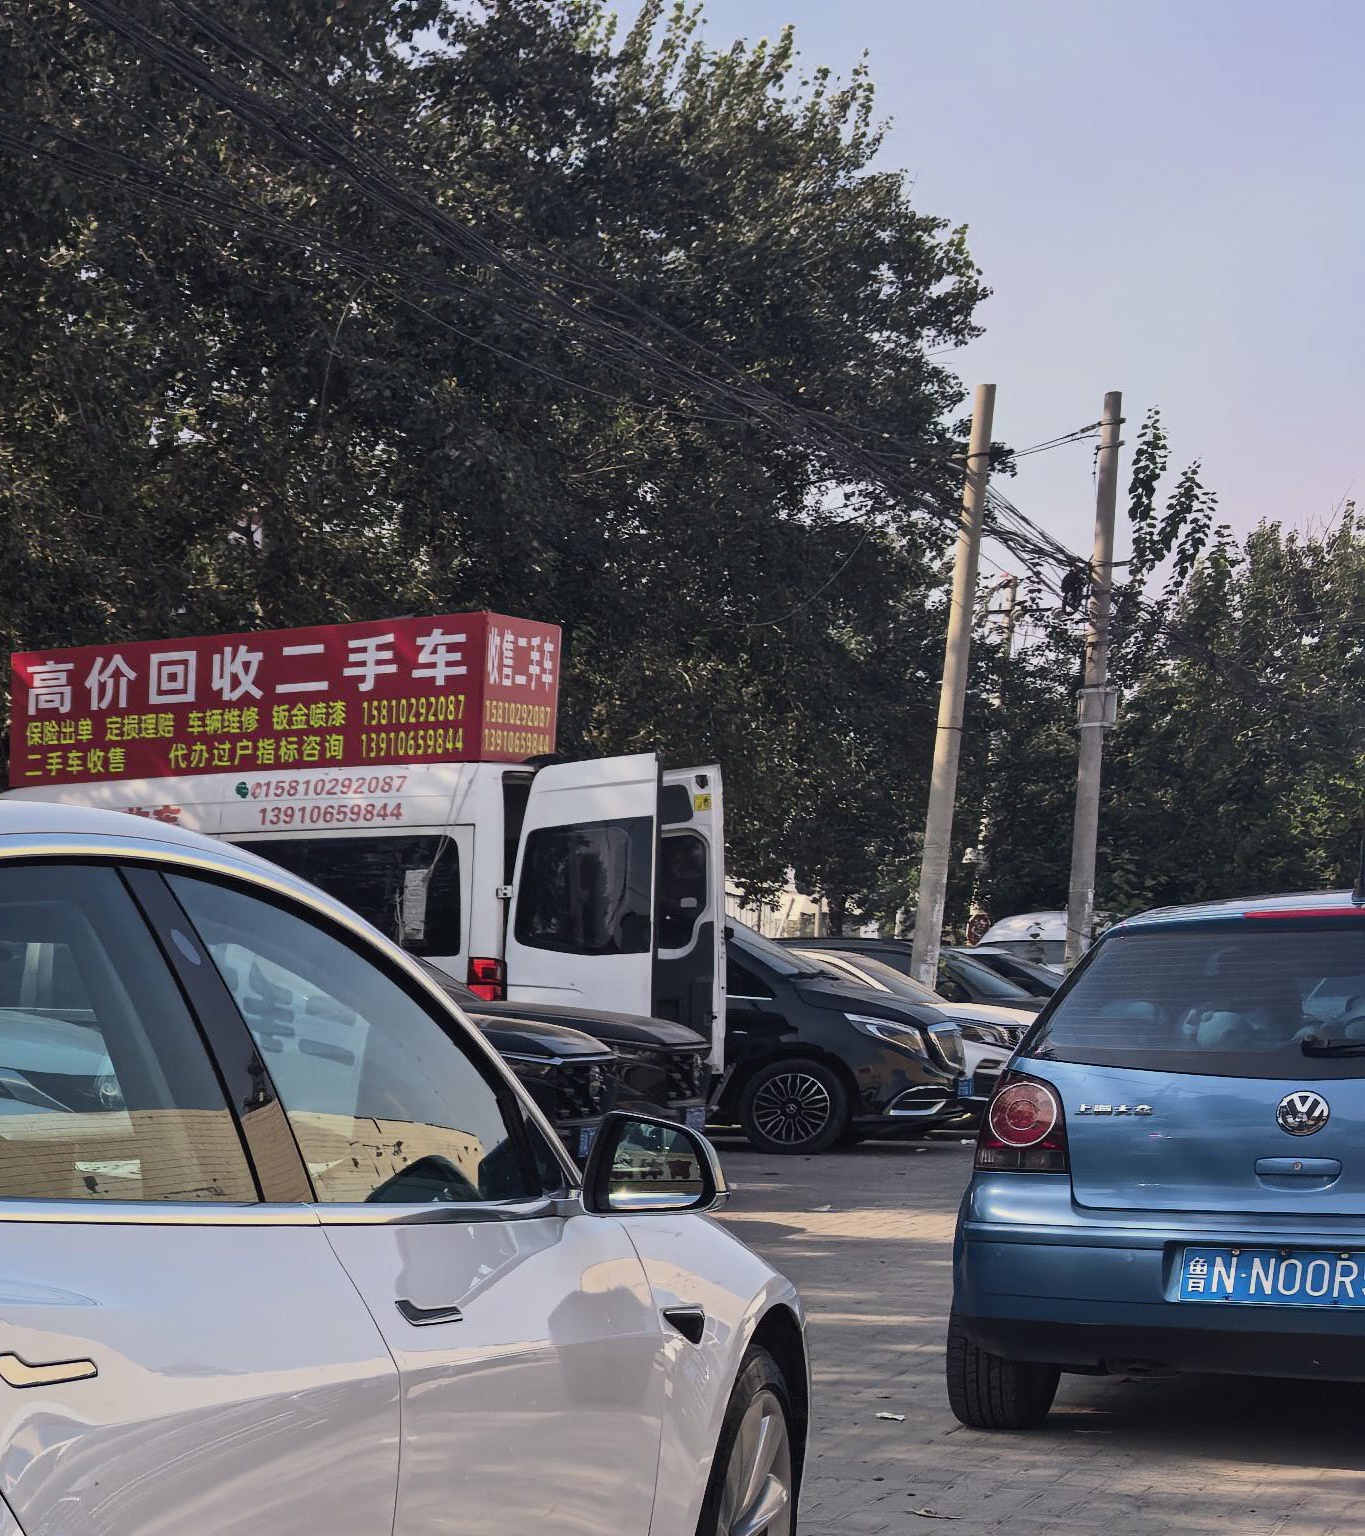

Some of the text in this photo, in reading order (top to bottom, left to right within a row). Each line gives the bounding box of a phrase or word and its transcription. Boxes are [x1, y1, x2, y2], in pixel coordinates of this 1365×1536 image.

[26, 629, 467, 715] 高价回收二手车
[487, 628, 554, 691] 收售二手车
[25, 695, 465, 747] 保险出单 定损理赔 车辆维修 钣金喷漆 15810292087
[485, 700, 551, 727] 15810292087
[25, 728, 464, 776] 二手车收售 代办过户指标咨询 13910659844
[485, 730, 550, 754] 13910659844
[259, 803, 403, 826] 13910659844
